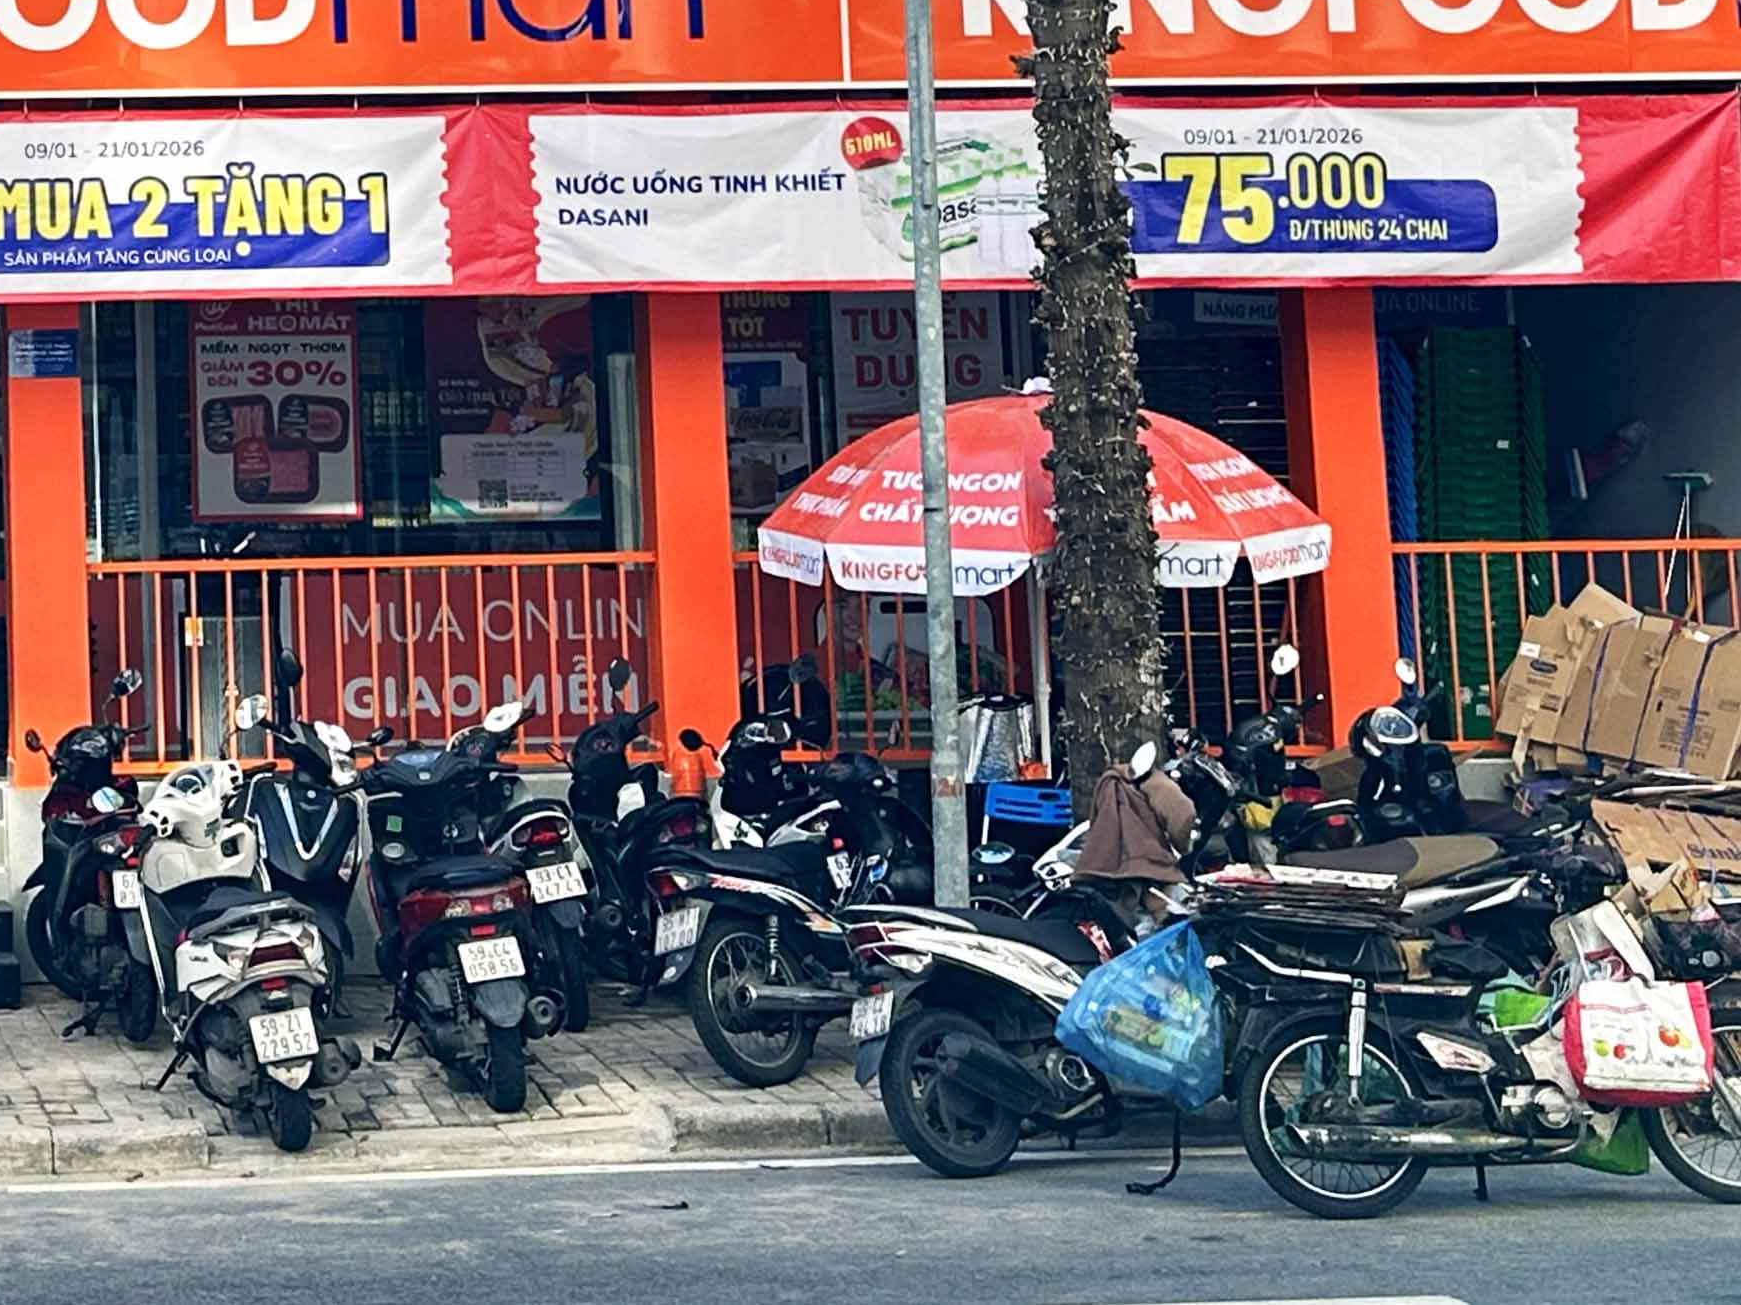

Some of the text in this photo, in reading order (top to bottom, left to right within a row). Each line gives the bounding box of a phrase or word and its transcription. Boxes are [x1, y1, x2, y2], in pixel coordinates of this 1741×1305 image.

[24, 140, 205, 160] 09/01 21/01/2026
[1183, 128, 1363, 146] 09/01 21/01/2026
[555, 167, 847, 196] NƯỚC UỐNG TINH KHIẾT
[132, 176, 170, 240] 2
[183, 161, 345, 257] TẶNG
[357, 172, 389, 234] 1
[1160, 151, 1388, 246] 75.000
[558, 208, 650, 228] DASANI
[1289, 215, 1448, 243] Đ/THÙNG 24 CHAI
[246, 359, 348, 387] 30%
[854, 353, 983, 398] DỤG
